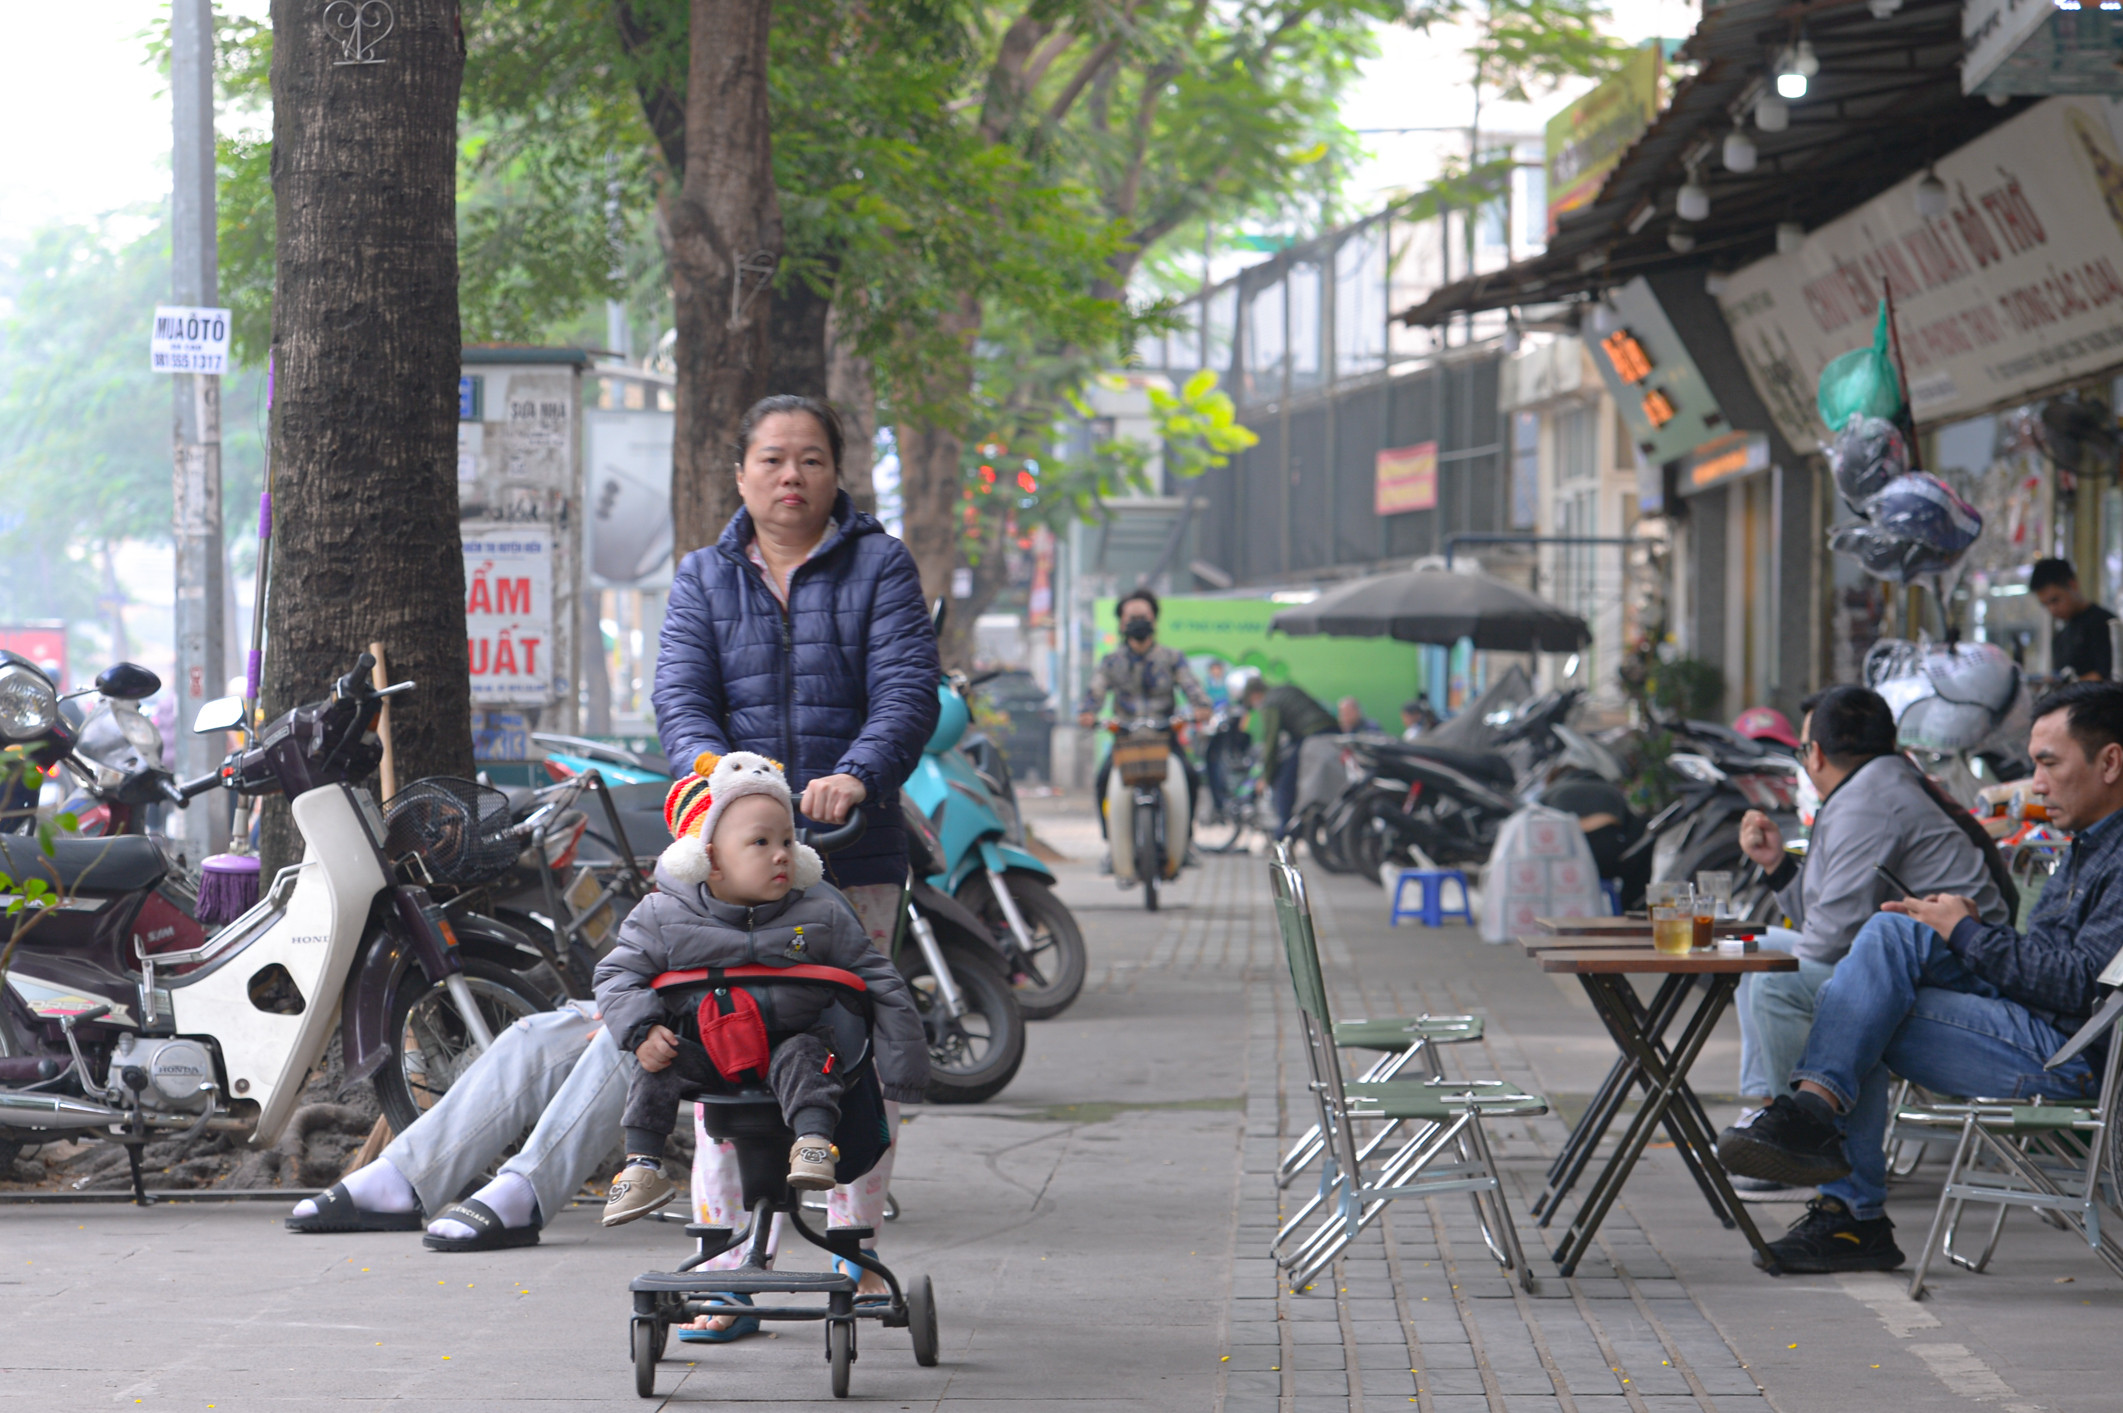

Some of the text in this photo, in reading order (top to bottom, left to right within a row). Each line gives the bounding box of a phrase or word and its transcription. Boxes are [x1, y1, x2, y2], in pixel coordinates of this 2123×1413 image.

[467, 560, 531, 614] ẨM
[468, 623, 541, 675] UẤT
[159, 1064, 199, 1073] HONDA
